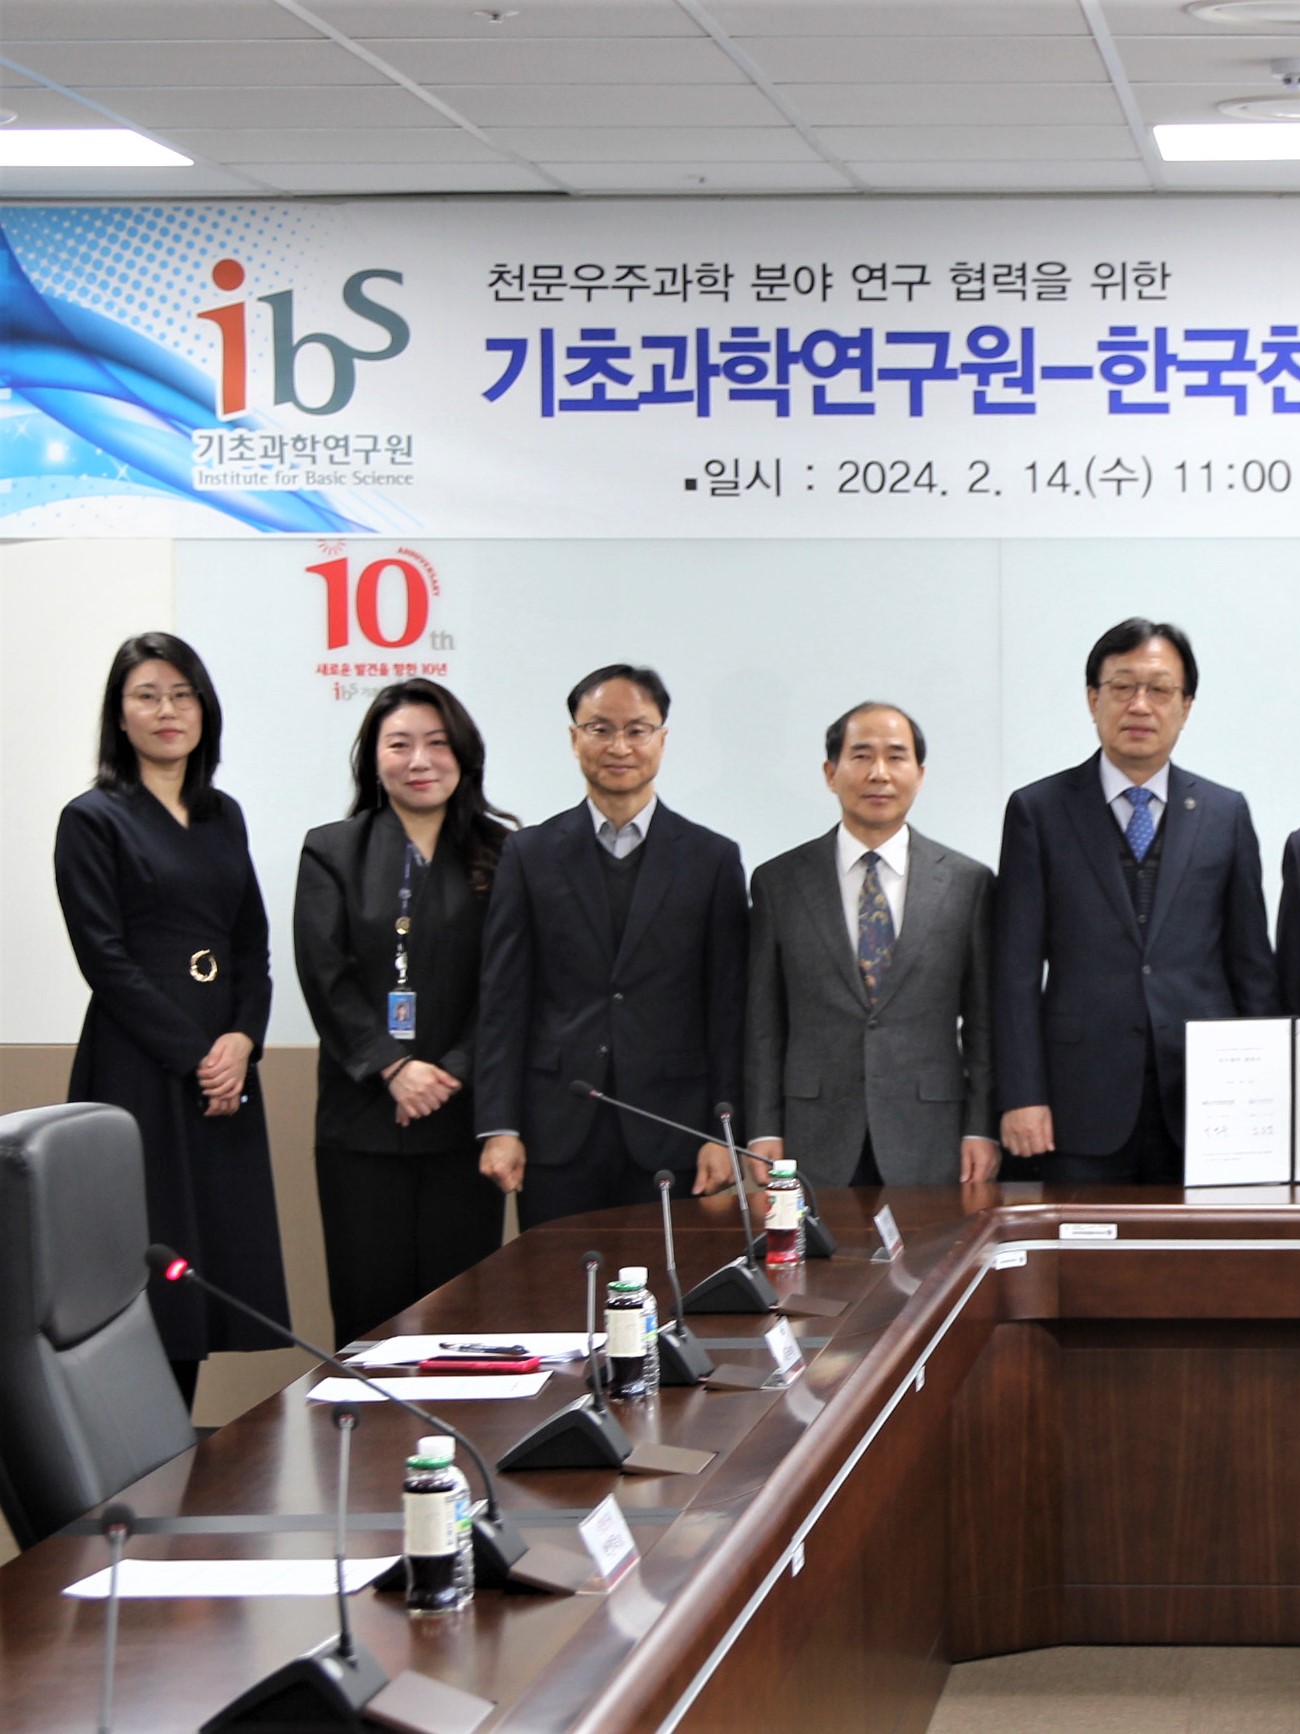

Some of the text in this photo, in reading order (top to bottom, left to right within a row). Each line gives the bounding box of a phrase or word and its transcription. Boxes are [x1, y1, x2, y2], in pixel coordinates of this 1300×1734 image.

[486, 260, 1172, 304] 천문우주과학 분야 연구 협력을 위한
[198, 433, 414, 467] 기초과학연구원
[198, 469, 414, 486] Institute for Basic Science
[837, 459, 948, 497] 2024.
[967, 459, 1002, 497] 2.
[1024, 455, 1153, 499] 14.(수)
[1175, 459, 1293, 493] 11:00
